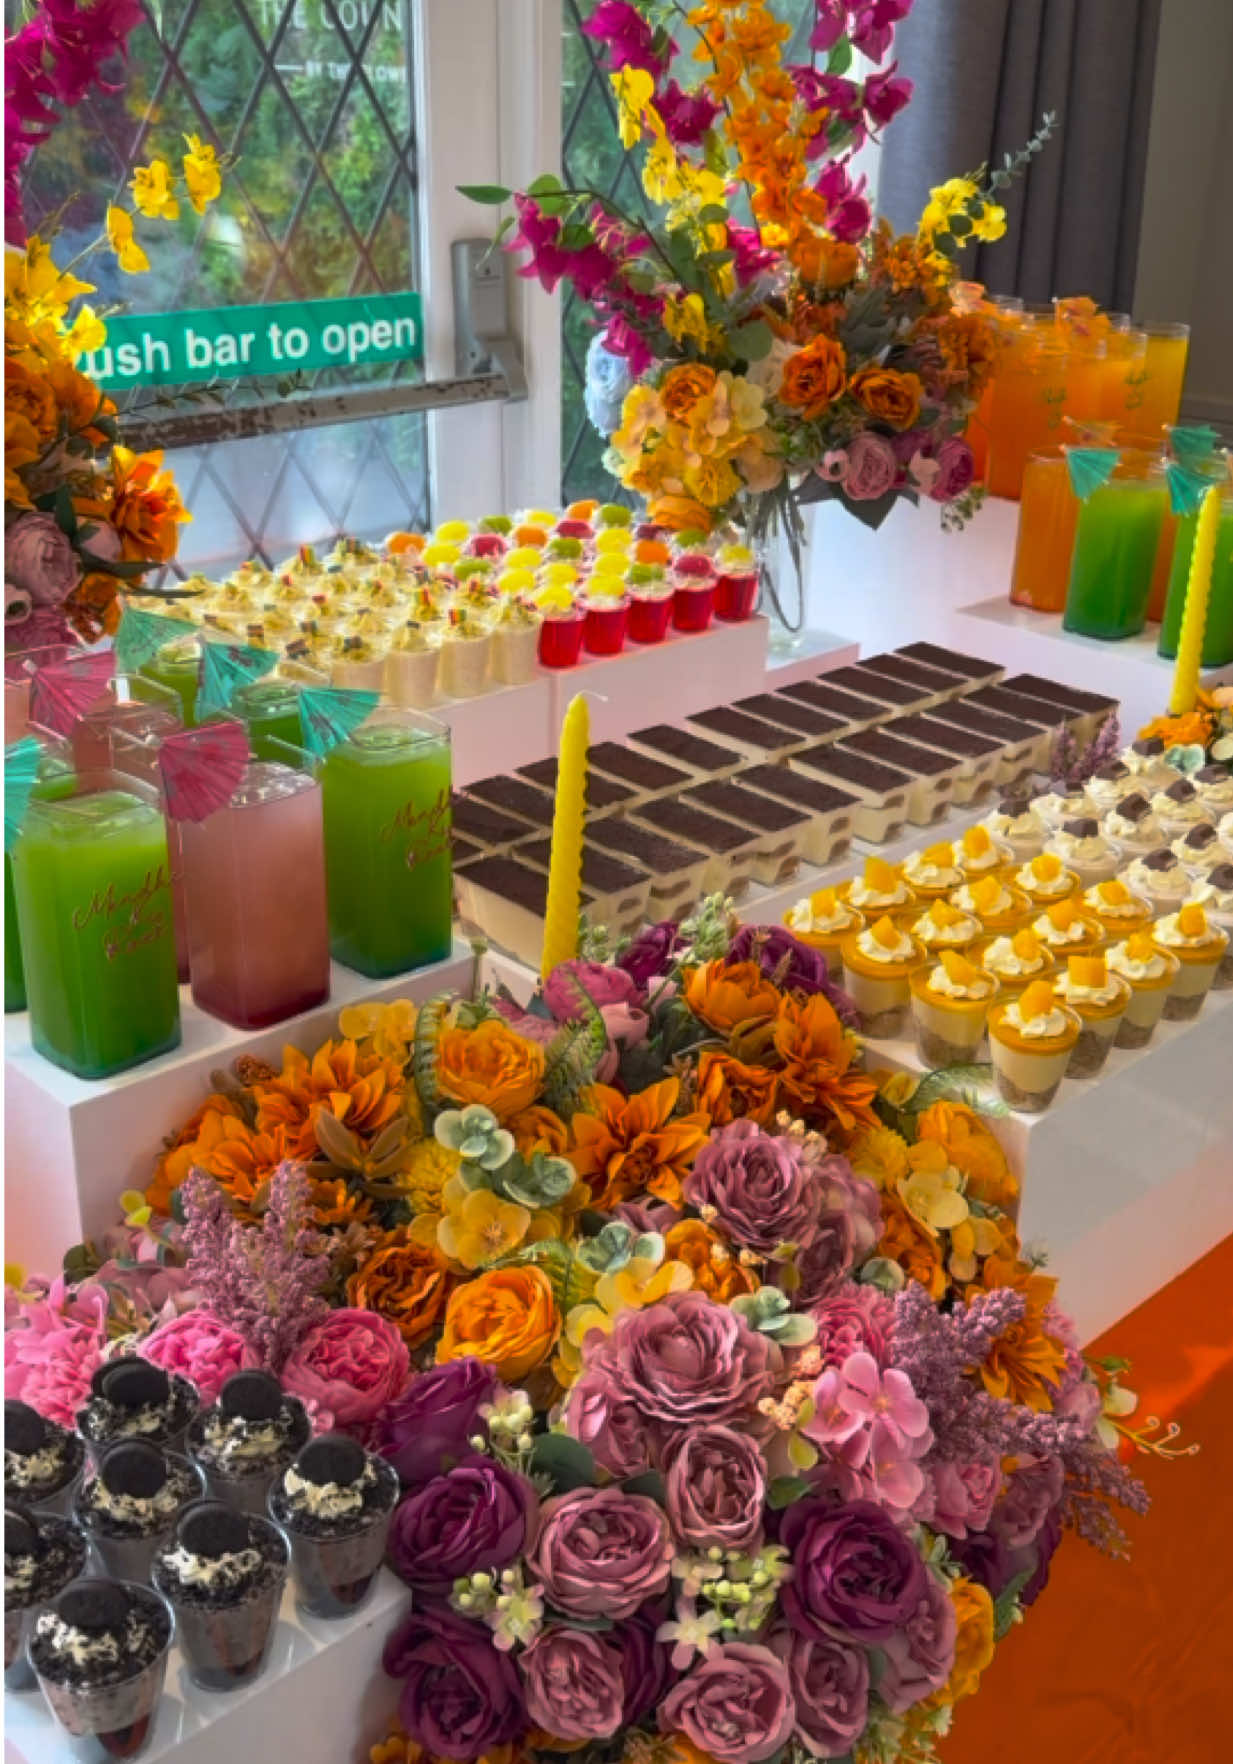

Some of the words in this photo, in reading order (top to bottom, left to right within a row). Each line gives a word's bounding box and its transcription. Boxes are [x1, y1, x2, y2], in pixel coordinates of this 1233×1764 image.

[79, 332, 171, 379] ush
[184, 328, 256, 369] bar
[268, 322, 310, 360] to
[321, 316, 416, 364] open
